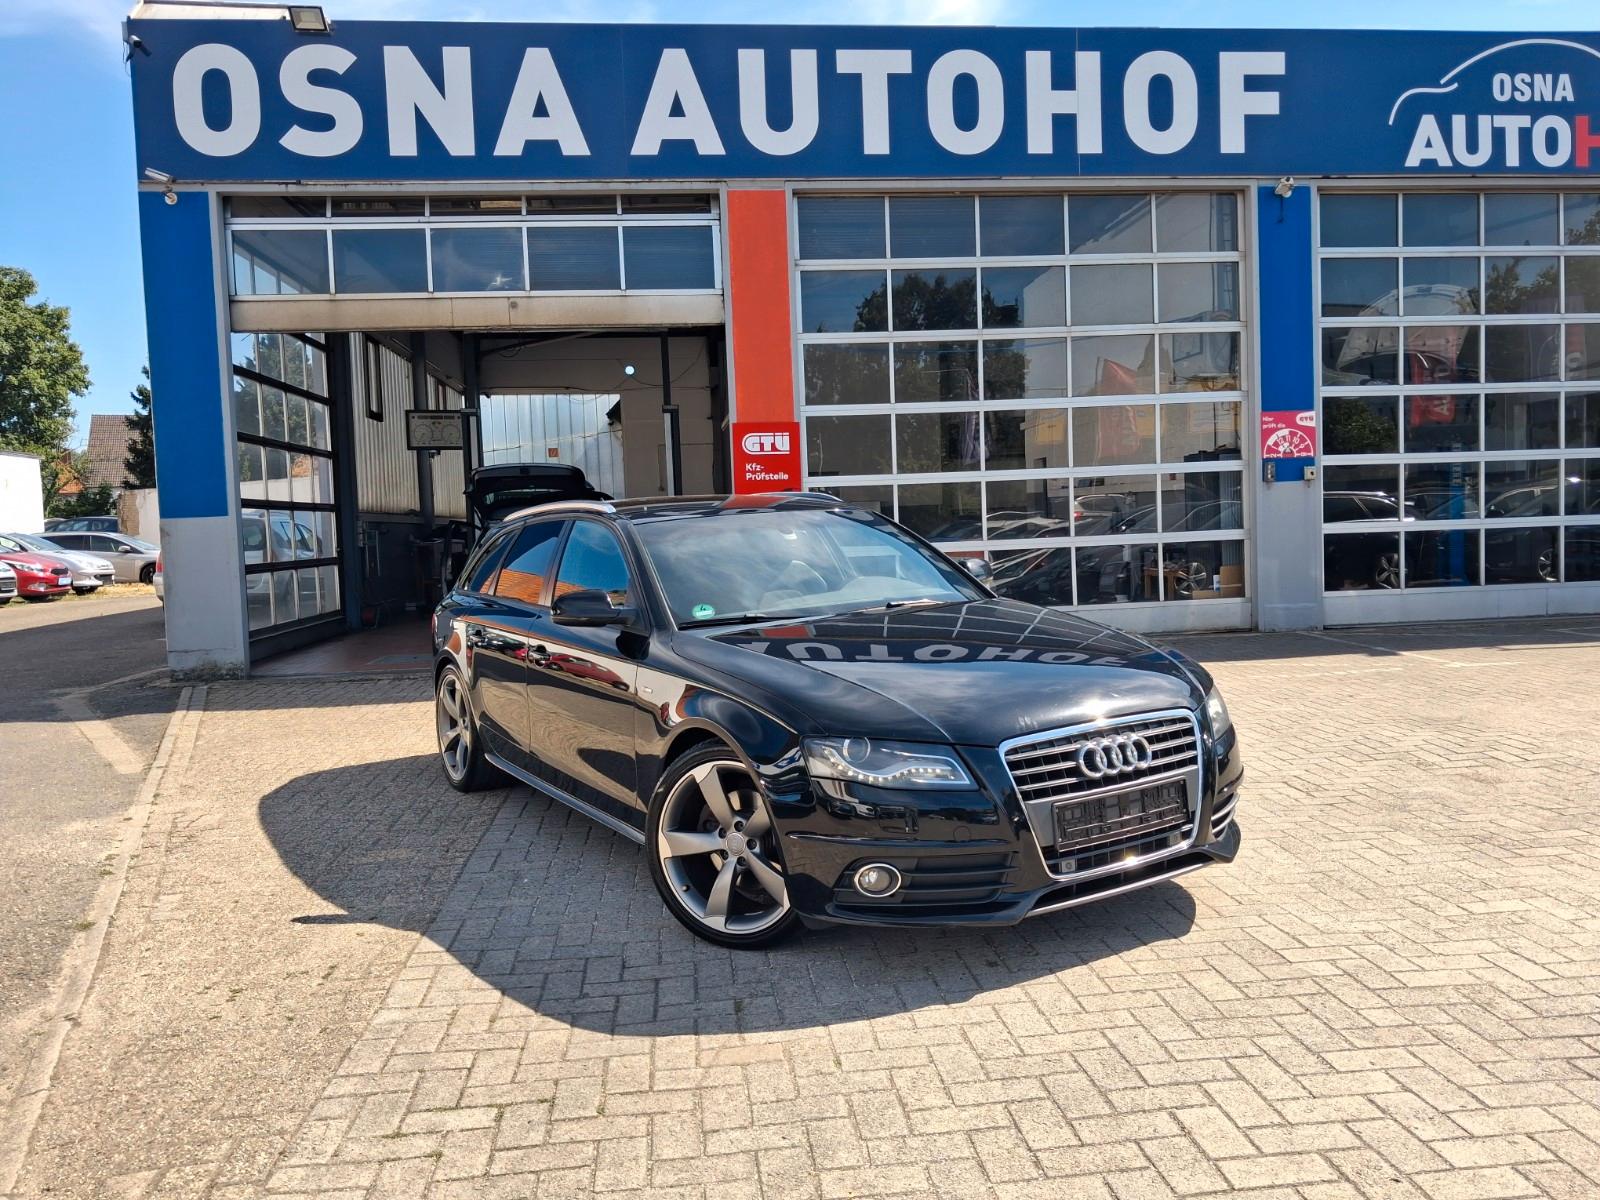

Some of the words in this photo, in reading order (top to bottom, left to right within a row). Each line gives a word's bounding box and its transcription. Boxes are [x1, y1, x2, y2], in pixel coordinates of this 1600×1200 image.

[1492, 72, 1575, 102] OSNA
[172, 43, 592, 158] OSNA
[630, 48, 1286, 156] AUTOHOF
[742, 432, 790, 455] GTÜ
[745, 463, 765, 471] Kfz-
[745, 472, 789, 481] Prüfstelle
